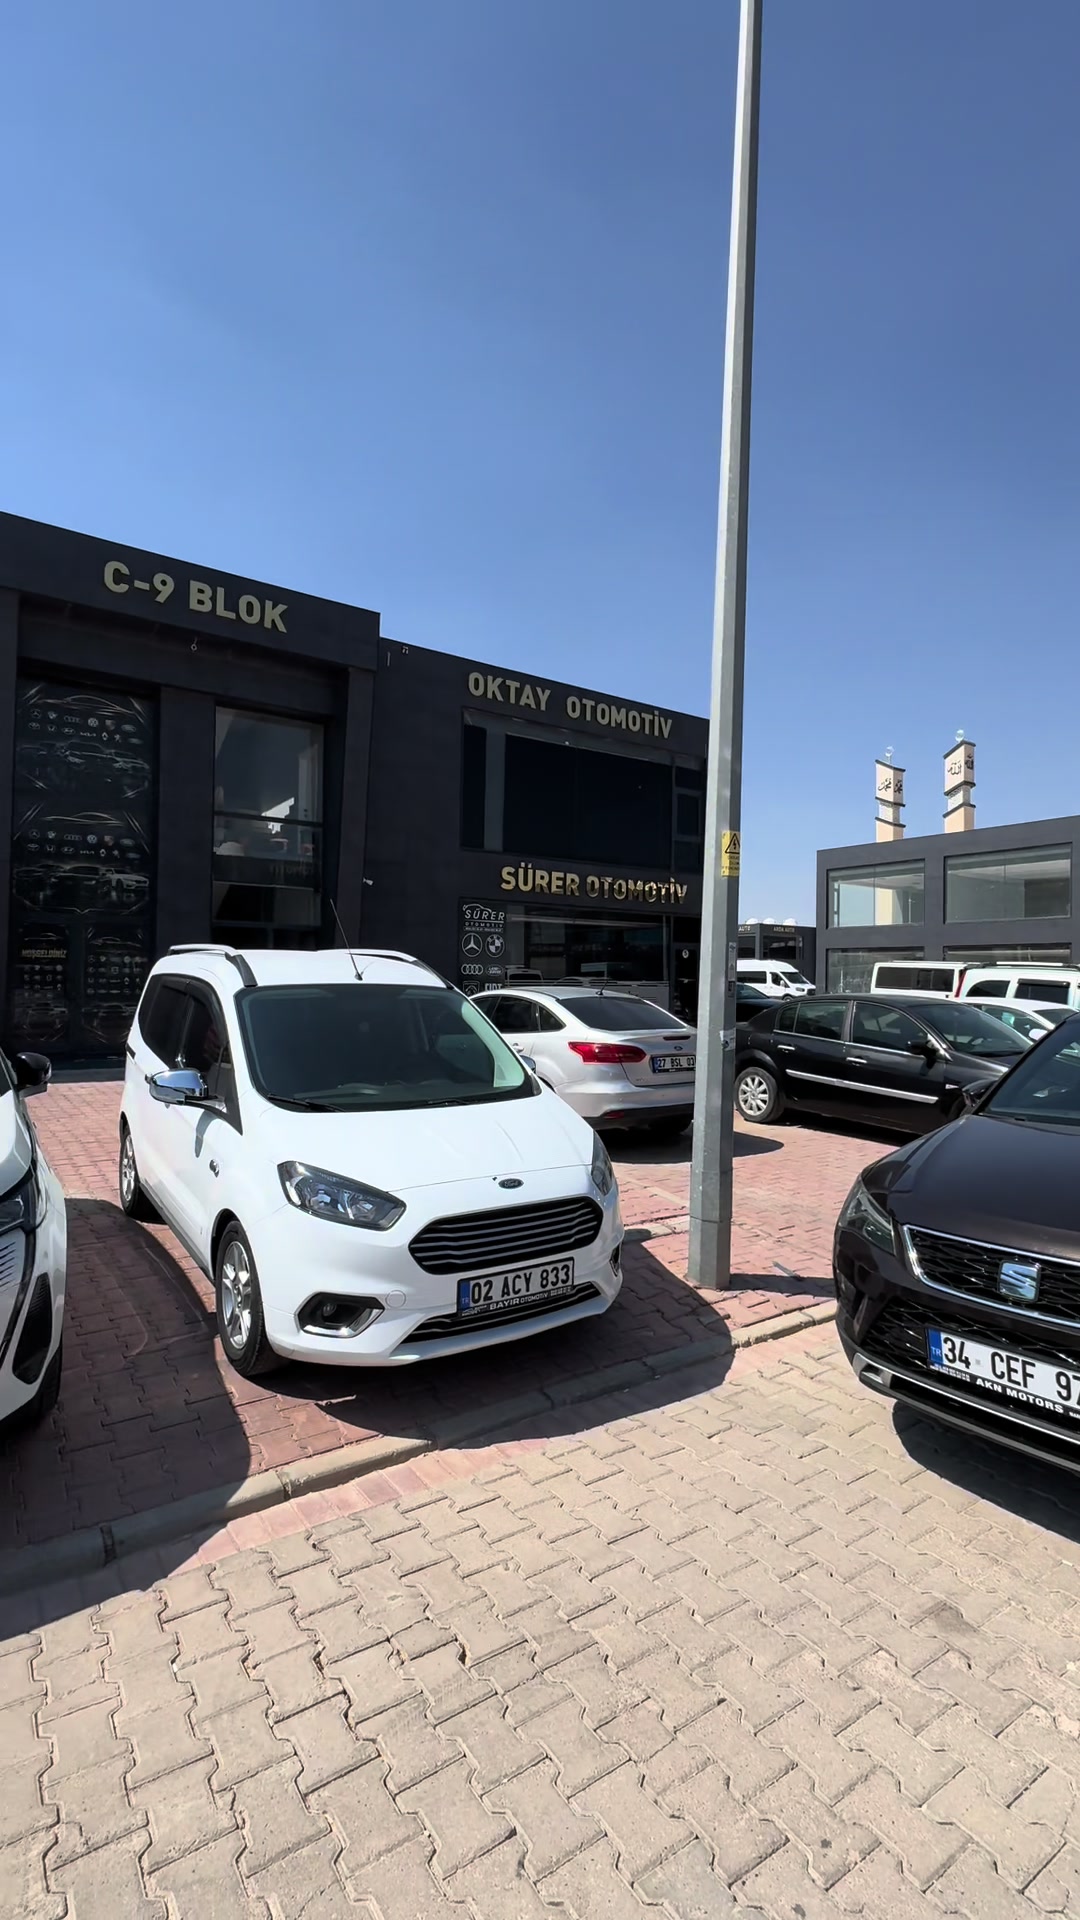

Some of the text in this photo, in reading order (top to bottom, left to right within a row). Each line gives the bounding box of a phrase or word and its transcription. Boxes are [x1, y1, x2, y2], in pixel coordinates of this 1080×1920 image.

[103, 560, 288, 634] C-9 BLOK
[468, 671, 673, 739] OKTAY OTOMOTİV
[500, 861, 688, 905] SÜRER OTOMOTİV
[471, 1280, 493, 1304] 02
[501, 1271, 532, 1298] ACY
[540, 1264, 570, 1289] 833
[931, 1346, 941, 1357] TR
[943, 1336, 971, 1369] 34
[990, 1351, 1036, 1389] CEF
[975, 1378, 1064, 1414] AKN MOTORS
